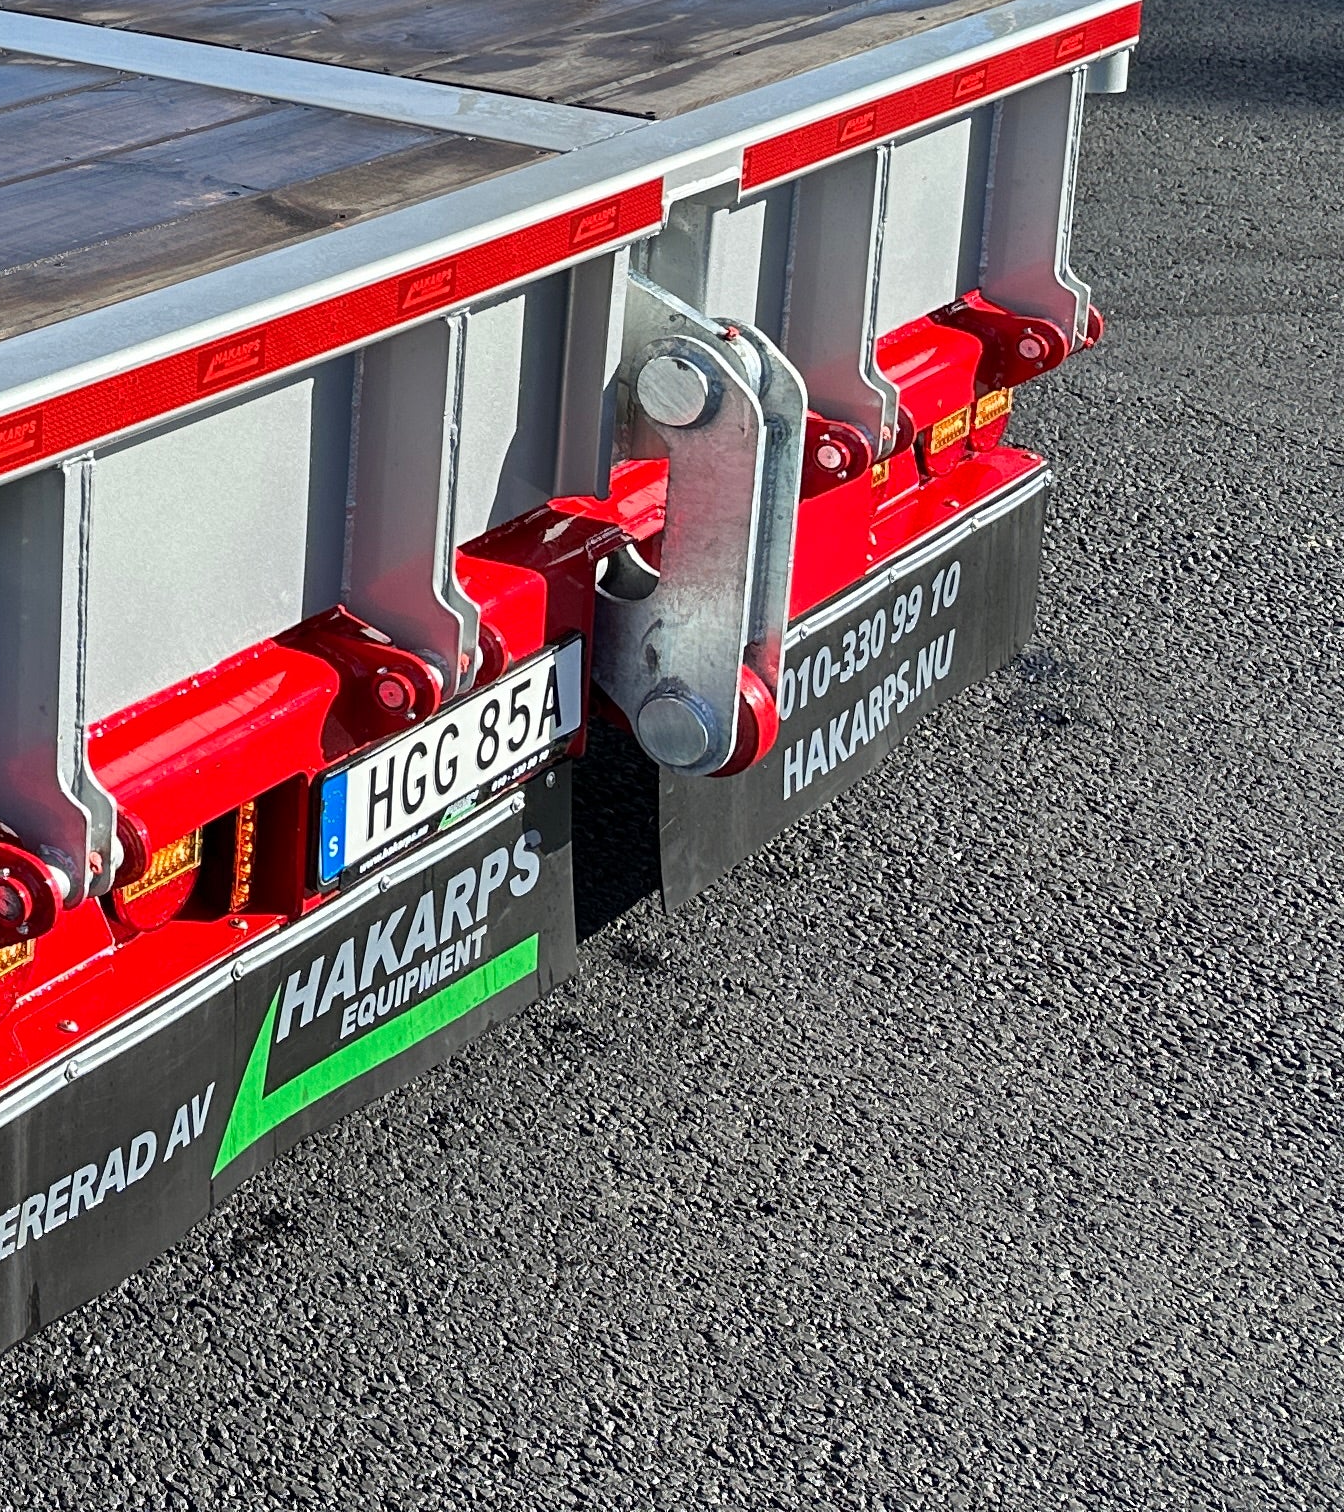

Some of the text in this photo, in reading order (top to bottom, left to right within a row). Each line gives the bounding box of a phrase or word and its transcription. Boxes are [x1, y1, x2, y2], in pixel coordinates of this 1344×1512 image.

[779, 560, 961, 721] 010-330 99 10
[783, 628, 957, 801] HAKARPS.NU
[366, 663, 562, 842] HGG 85A
[328, 835, 339, 858] S
[275, 829, 542, 1043] HAKARPS
[339, 925, 489, 1039] EQUIPMENT
[162, 1083, 216, 1164] AV
